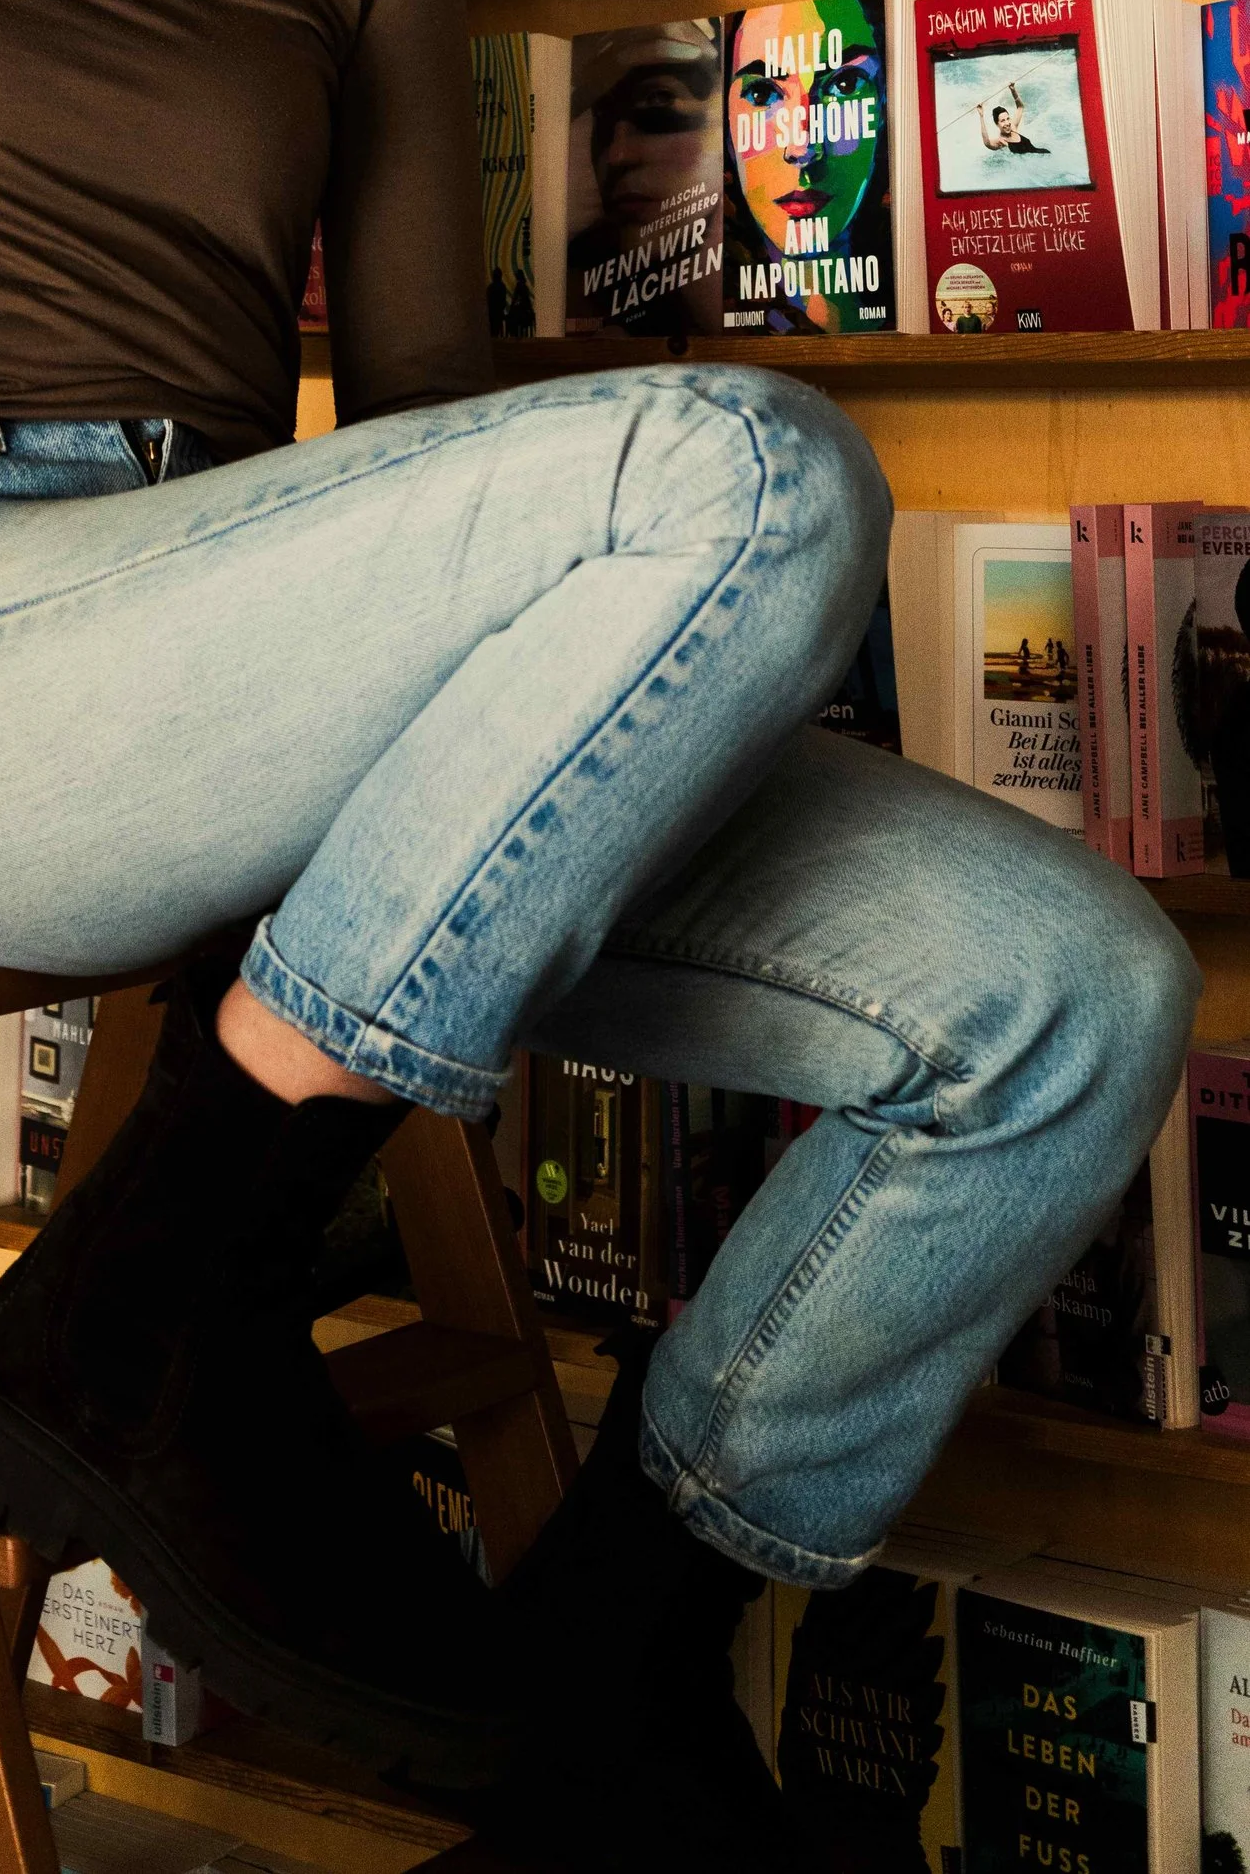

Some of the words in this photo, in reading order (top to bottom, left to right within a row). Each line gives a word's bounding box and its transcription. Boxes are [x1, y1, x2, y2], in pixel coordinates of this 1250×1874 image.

[928, 8, 987, 36] JOACHIM
[765, 29, 842, 78] HALLO
[738, 110, 767, 152] DU
[776, 96, 876, 146] SCHÖNE
[661, 183, 705, 212] MASCHA
[785, 217, 829, 255] ANN
[951, 233, 1036, 256] ENTSETZLICHE
[1044, 230, 1085, 252] LÜCKE
[584, 242, 652, 296] WENN
[659, 218, 706, 262] WIR
[611, 242, 724, 316] LÄCHELN
[739, 255, 879, 300] NAPOLITANO
[735, 310, 765, 326] DUMONT
[991, 708, 1051, 729] Gianni
[1009, 732, 1038, 749] Bei
[1013, 752, 1035, 769] ist
[1039, 754, 1081, 771] alles
[1140, 733, 1148, 793] CAMPBELL
[580, 1212, 613, 1236] Yael
[558, 1240, 593, 1260] van
[600, 1242, 638, 1269] der
[543, 1259, 648, 1310] Wouden
[1204, 1380, 1229, 1403] atb
[62, 1582, 95, 1606] DAS
[73, 1628, 116, 1655] HERZ
[983, 1620, 1053, 1652] Sebastian
[1059, 1640, 1118, 1669] Haffner
[154, 1682, 162, 1736] ullstein
[809, 1670, 852, 1707] ALS
[861, 1680, 913, 1723] WIR
[1022, 1682, 1077, 1721] DAS
[799, 1706, 922, 1764] SCHWÄNE
[1008, 1727, 1097, 1778] LEBEN
[816, 1747, 906, 1798] WAREN
[1025, 1785, 1081, 1824] DER
